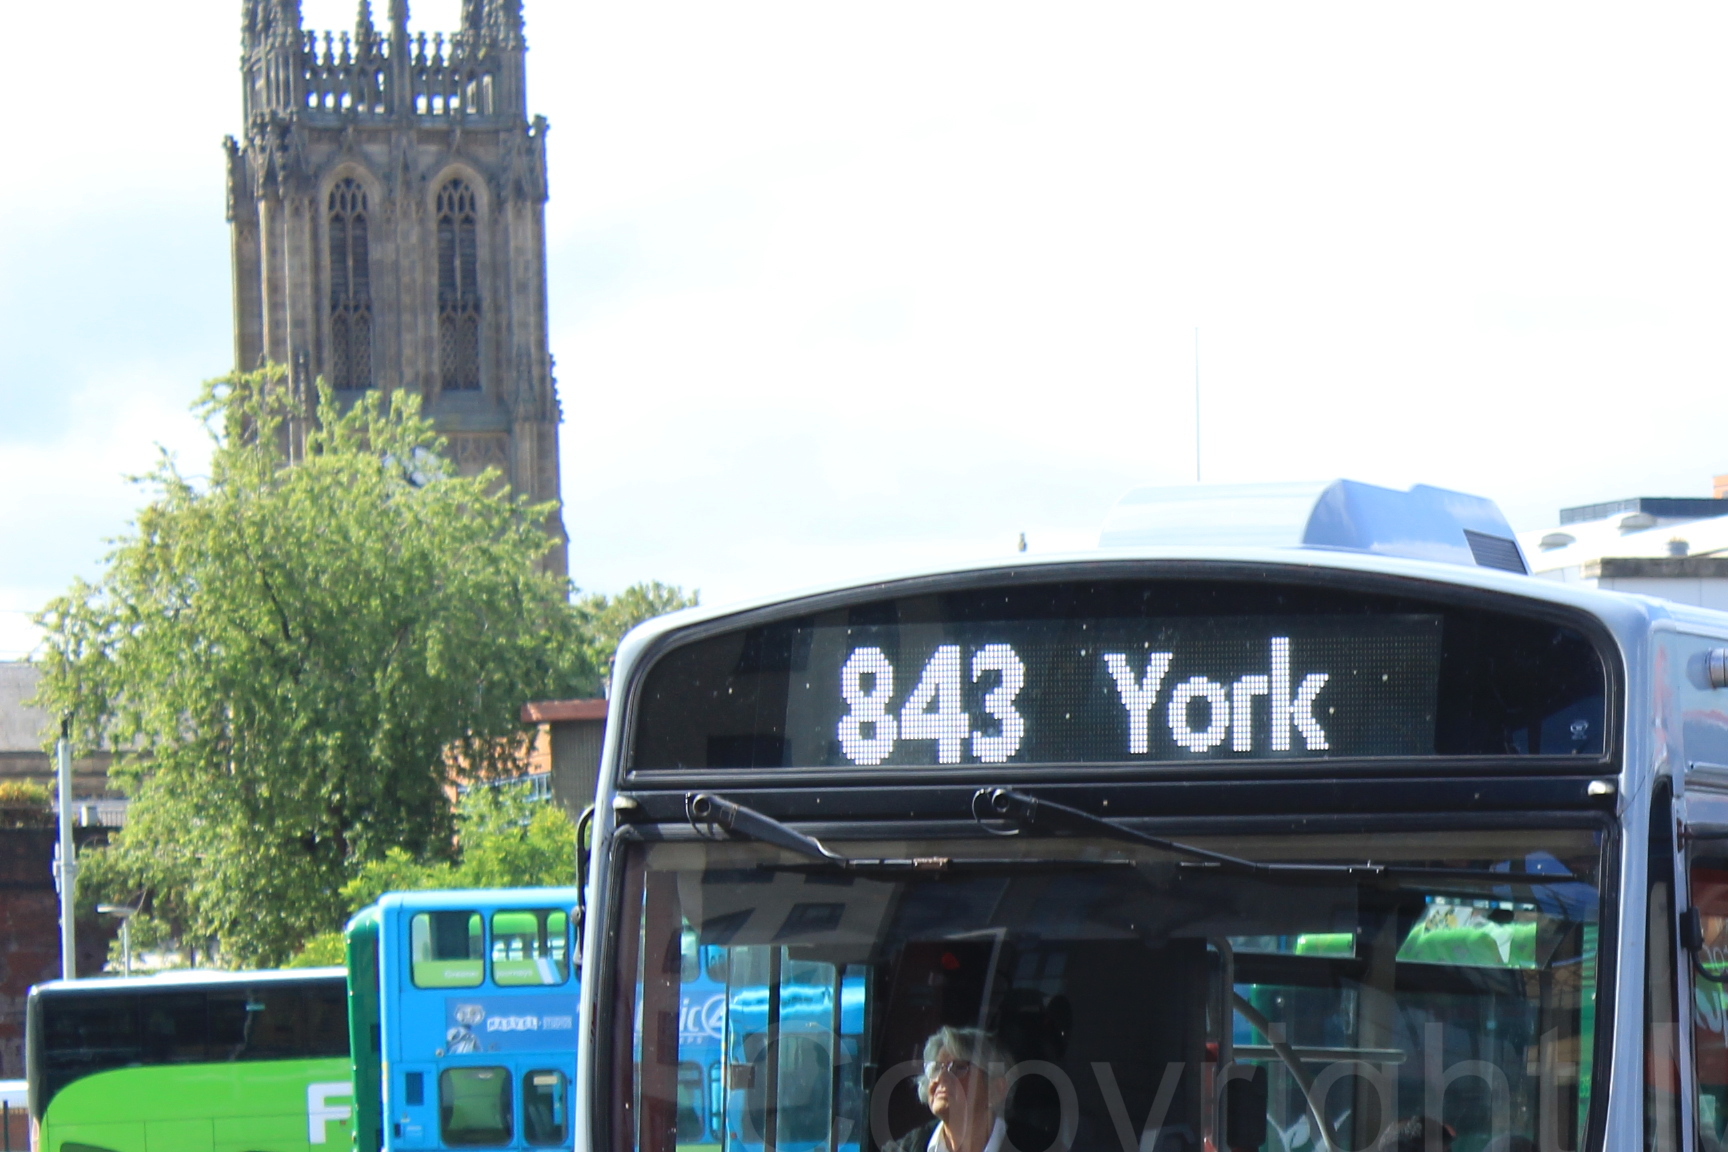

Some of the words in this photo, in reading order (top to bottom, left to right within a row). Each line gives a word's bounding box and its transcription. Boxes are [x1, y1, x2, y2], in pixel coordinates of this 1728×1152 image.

[837, 643, 1025, 765] 843
[1103, 637, 1330, 755] York
[486, 1016, 538, 1032] MARVEL
